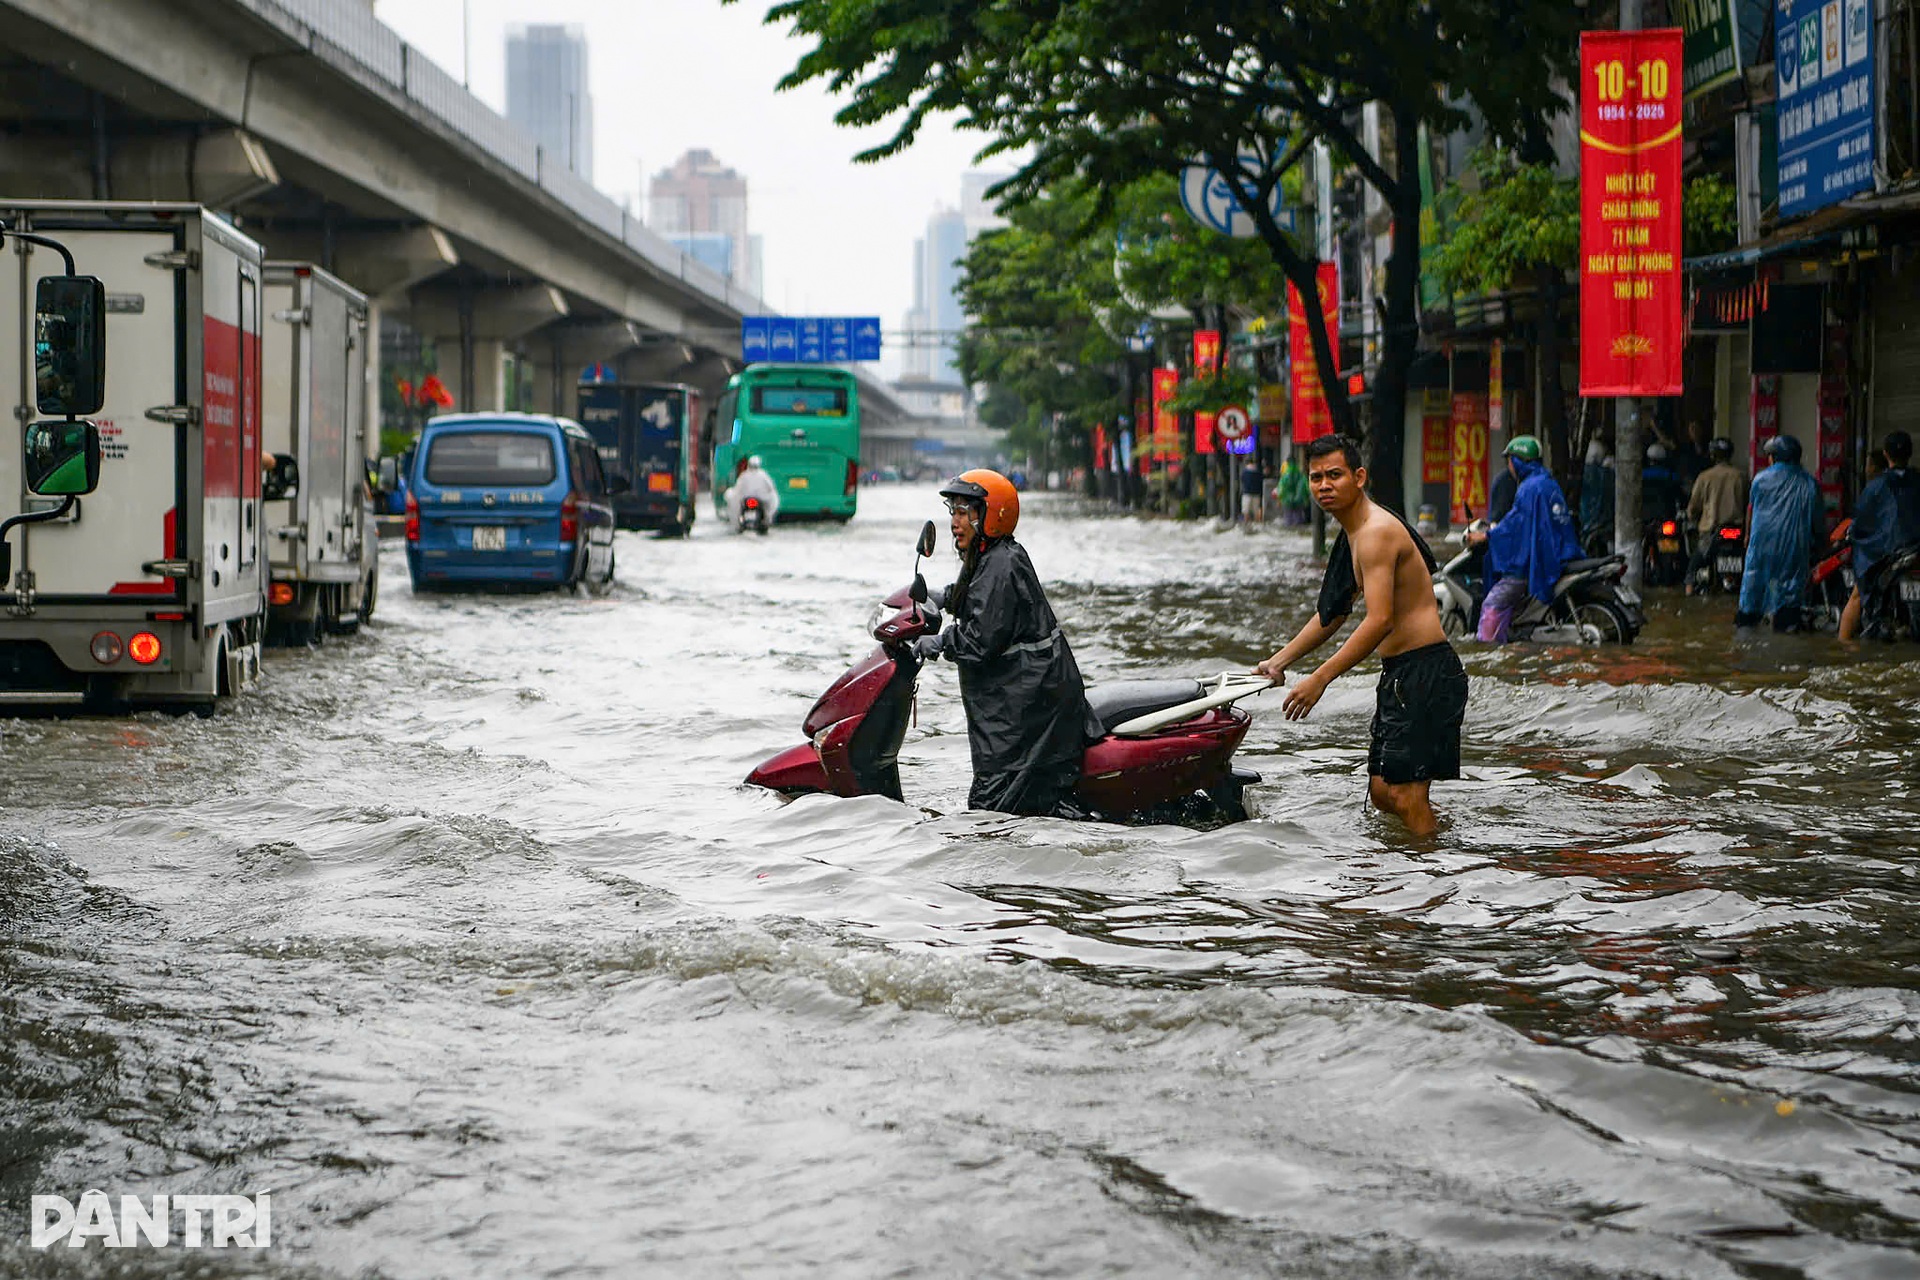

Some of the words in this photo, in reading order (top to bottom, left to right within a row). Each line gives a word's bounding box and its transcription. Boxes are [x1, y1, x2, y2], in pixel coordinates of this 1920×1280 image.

[1606, 170, 1634, 195] NHIỆT
[1636, 169, 1656, 195] LIỆT
[1602, 200, 1628, 219] CHÀO
[1630, 199, 1660, 219] MỪNG
[1612, 227, 1623, 246] 71
[1626, 226, 1649, 246] NĂM
[1589, 252, 1615, 272] NGÀY
[1617, 249, 1636, 272] GIẢI
[1639, 250, 1672, 272] PHÓNG
[1613, 276, 1632, 299] THỦ
[1454, 422, 1486, 463] SO
[1453, 465, 1486, 506] FA
